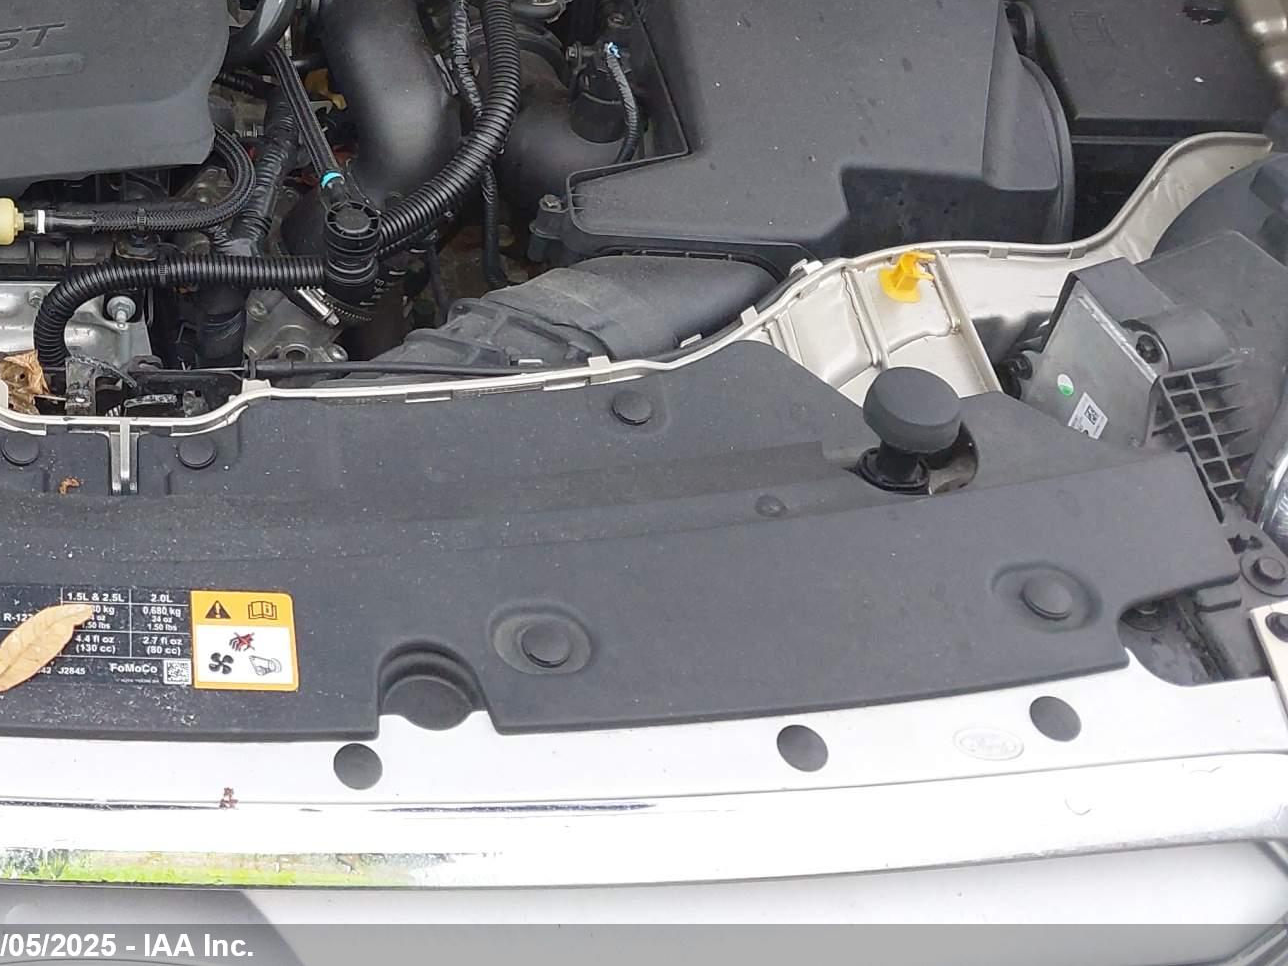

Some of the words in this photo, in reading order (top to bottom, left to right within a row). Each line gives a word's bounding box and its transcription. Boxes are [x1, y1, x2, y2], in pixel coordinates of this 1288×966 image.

[67, 592, 89, 602] 1.5L
[91, 593, 101, 602] &
[102, 593, 125, 603] 2.5L
[150, 594, 173, 603] 2.0L
[103, 605, 115, 616] kg
[169, 607, 182, 617] kg
[75, 635, 92, 643] 4.4
[142, 636, 159, 645] 2.7
[99, 644, 116, 654] cc)
[164, 646, 181, 655] cc)
[109, 662, 158, 674] FoMoCo
